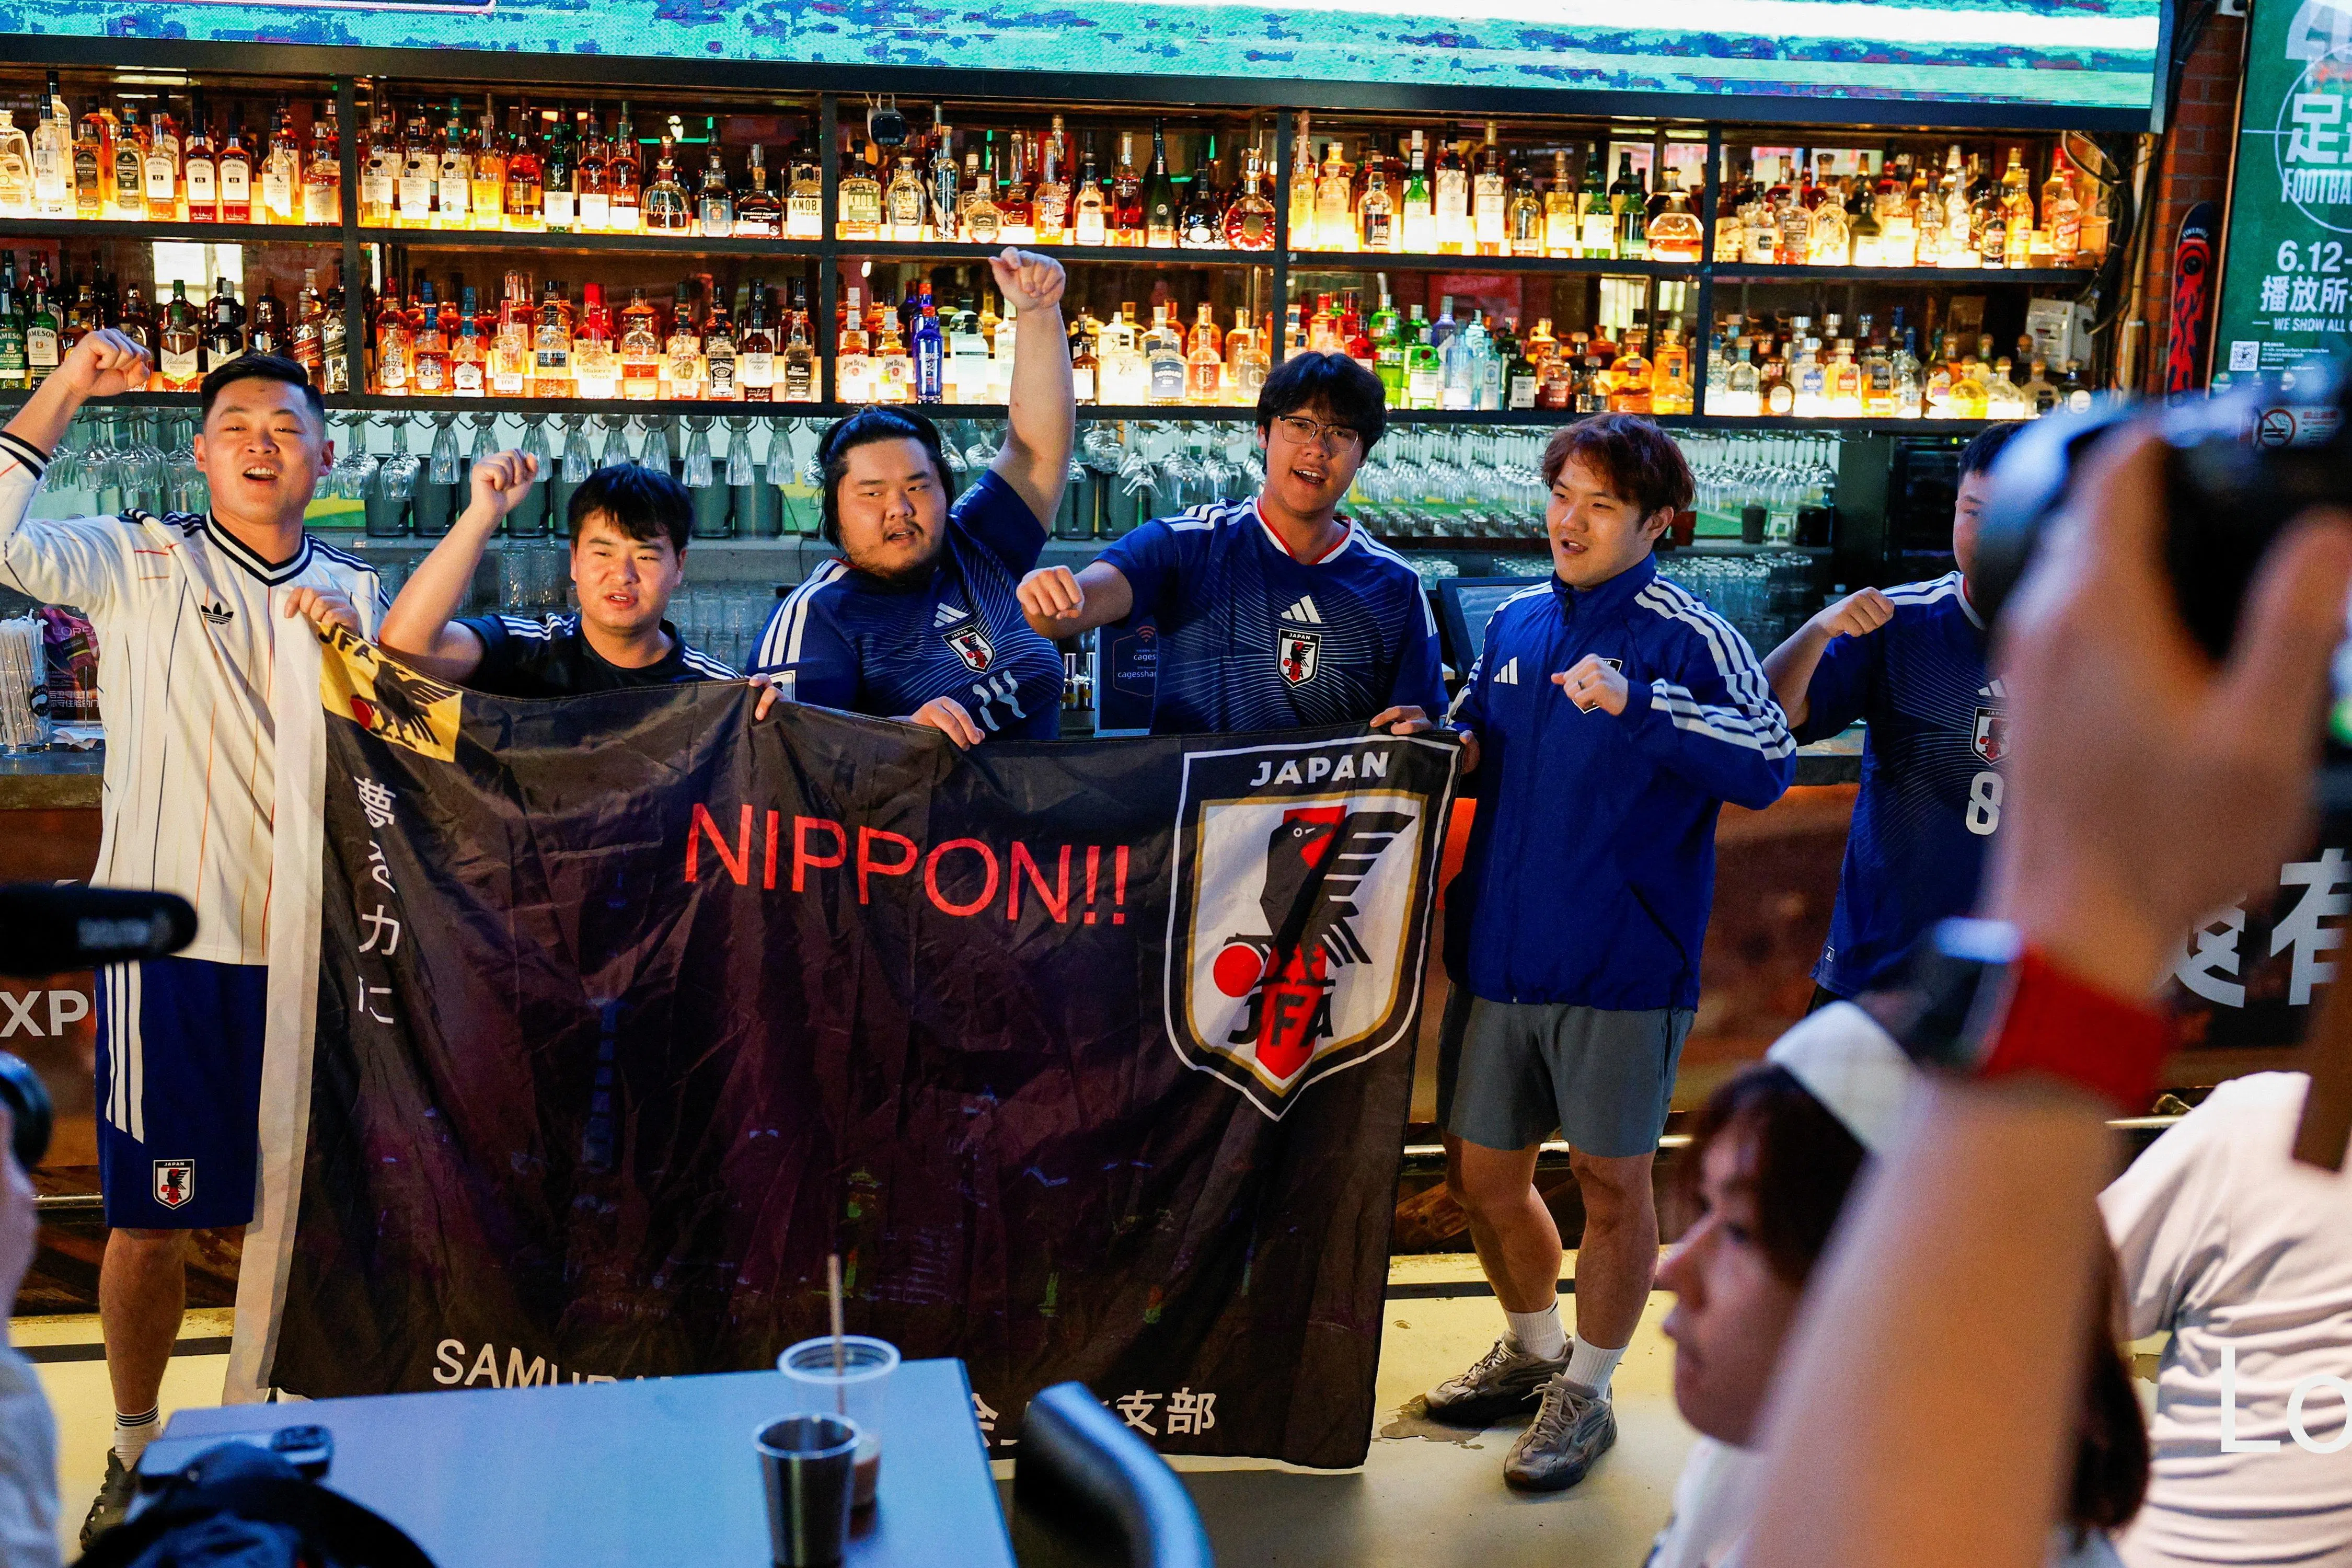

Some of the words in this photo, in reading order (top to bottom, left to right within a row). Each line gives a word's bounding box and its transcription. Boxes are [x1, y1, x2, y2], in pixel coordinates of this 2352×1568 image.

[2286, 93, 2352, 164] 足
[650, 204, 675, 220] 1792
[792, 200, 817, 211] KNOB
[849, 195, 873, 206] KNOB
[2260, 274, 2352, 314] 播放所
[2274, 317, 2290, 330] WE
[2292, 318, 2326, 331] SHOW
[2326, 318, 2346, 332] ALL
[951, 629, 969, 639] JAPAN
[1250, 752, 1389, 787] JAPAN
[1965, 771, 2004, 835] 8
[684, 802, 1129, 925] NIPPON!!
[1227, 993, 1335, 1047] JFA
